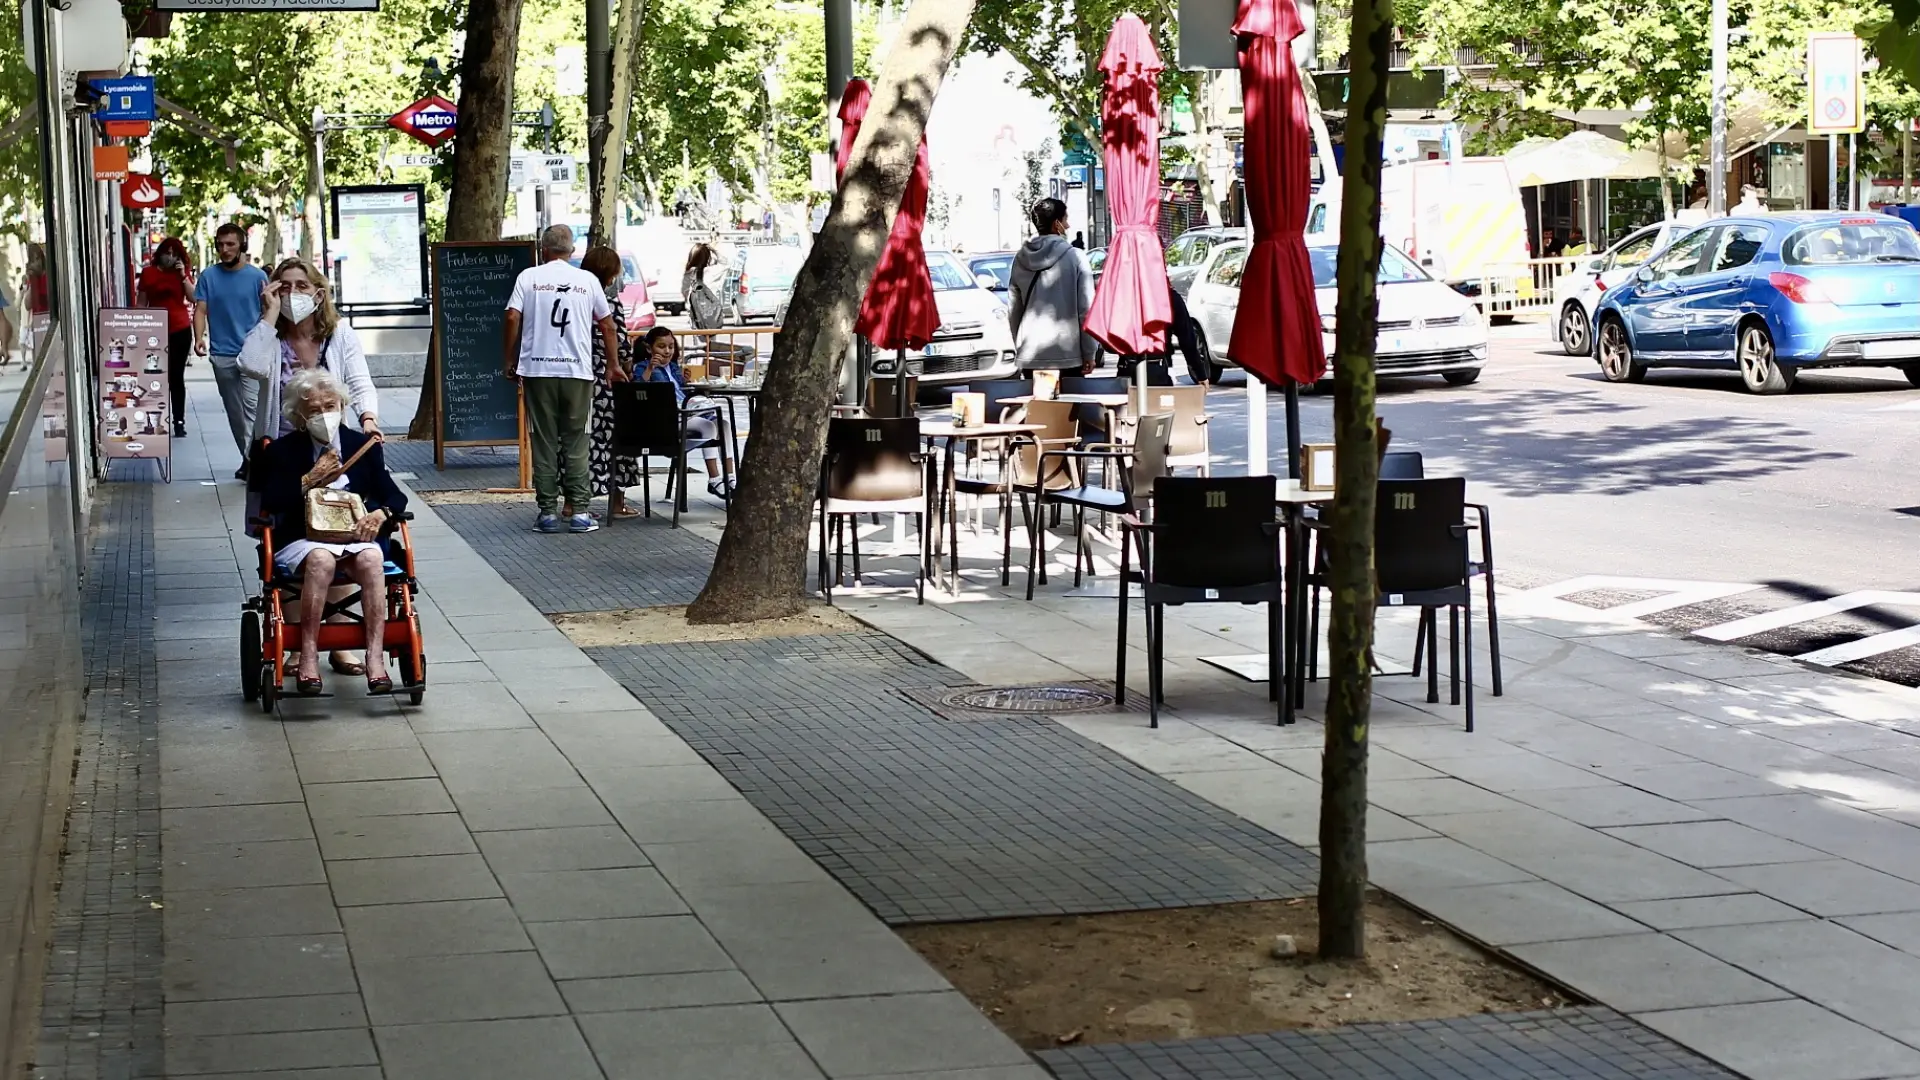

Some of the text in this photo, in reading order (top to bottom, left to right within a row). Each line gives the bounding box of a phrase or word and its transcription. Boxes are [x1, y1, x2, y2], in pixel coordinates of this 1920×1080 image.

[104, 84, 147, 93] Lycamobile
[415, 113, 453, 126] Metro
[406, 156, 416, 165] El
[96, 171, 126, 179] orange
[533, 283, 587, 295] Ruedo Arte
[550, 298, 571, 338] 4
[864, 427, 883, 442] m
[1205, 490, 1228, 508] m
[1394, 492, 1416, 510] m
